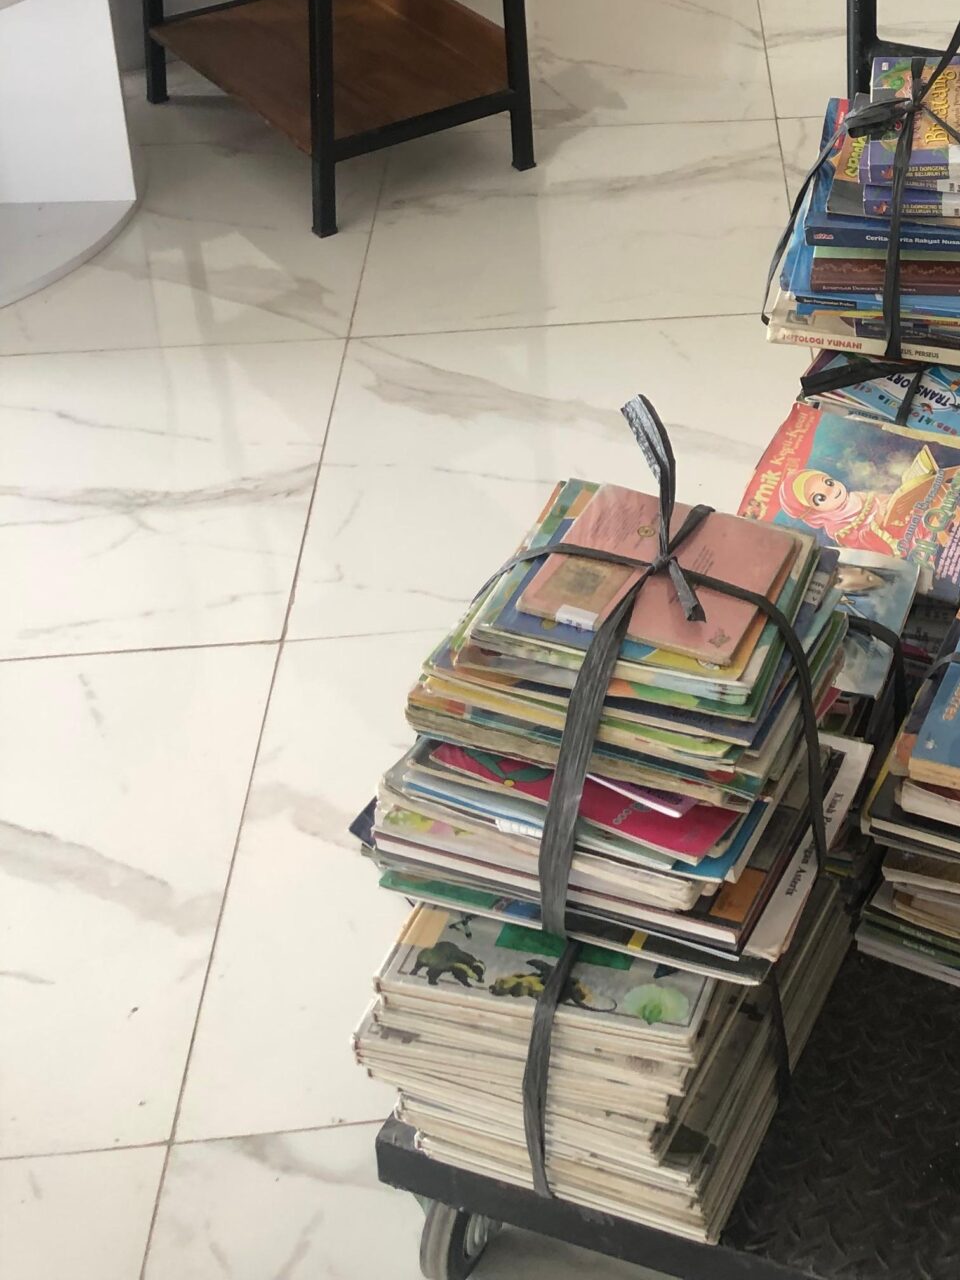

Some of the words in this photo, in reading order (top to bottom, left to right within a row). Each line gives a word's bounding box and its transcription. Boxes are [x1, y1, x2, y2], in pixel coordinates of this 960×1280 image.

[827, 339, 862, 350] YUNANI
[914, 350, 939, 358] PERSEUS
[785, 866, 807, 897] Asterix
